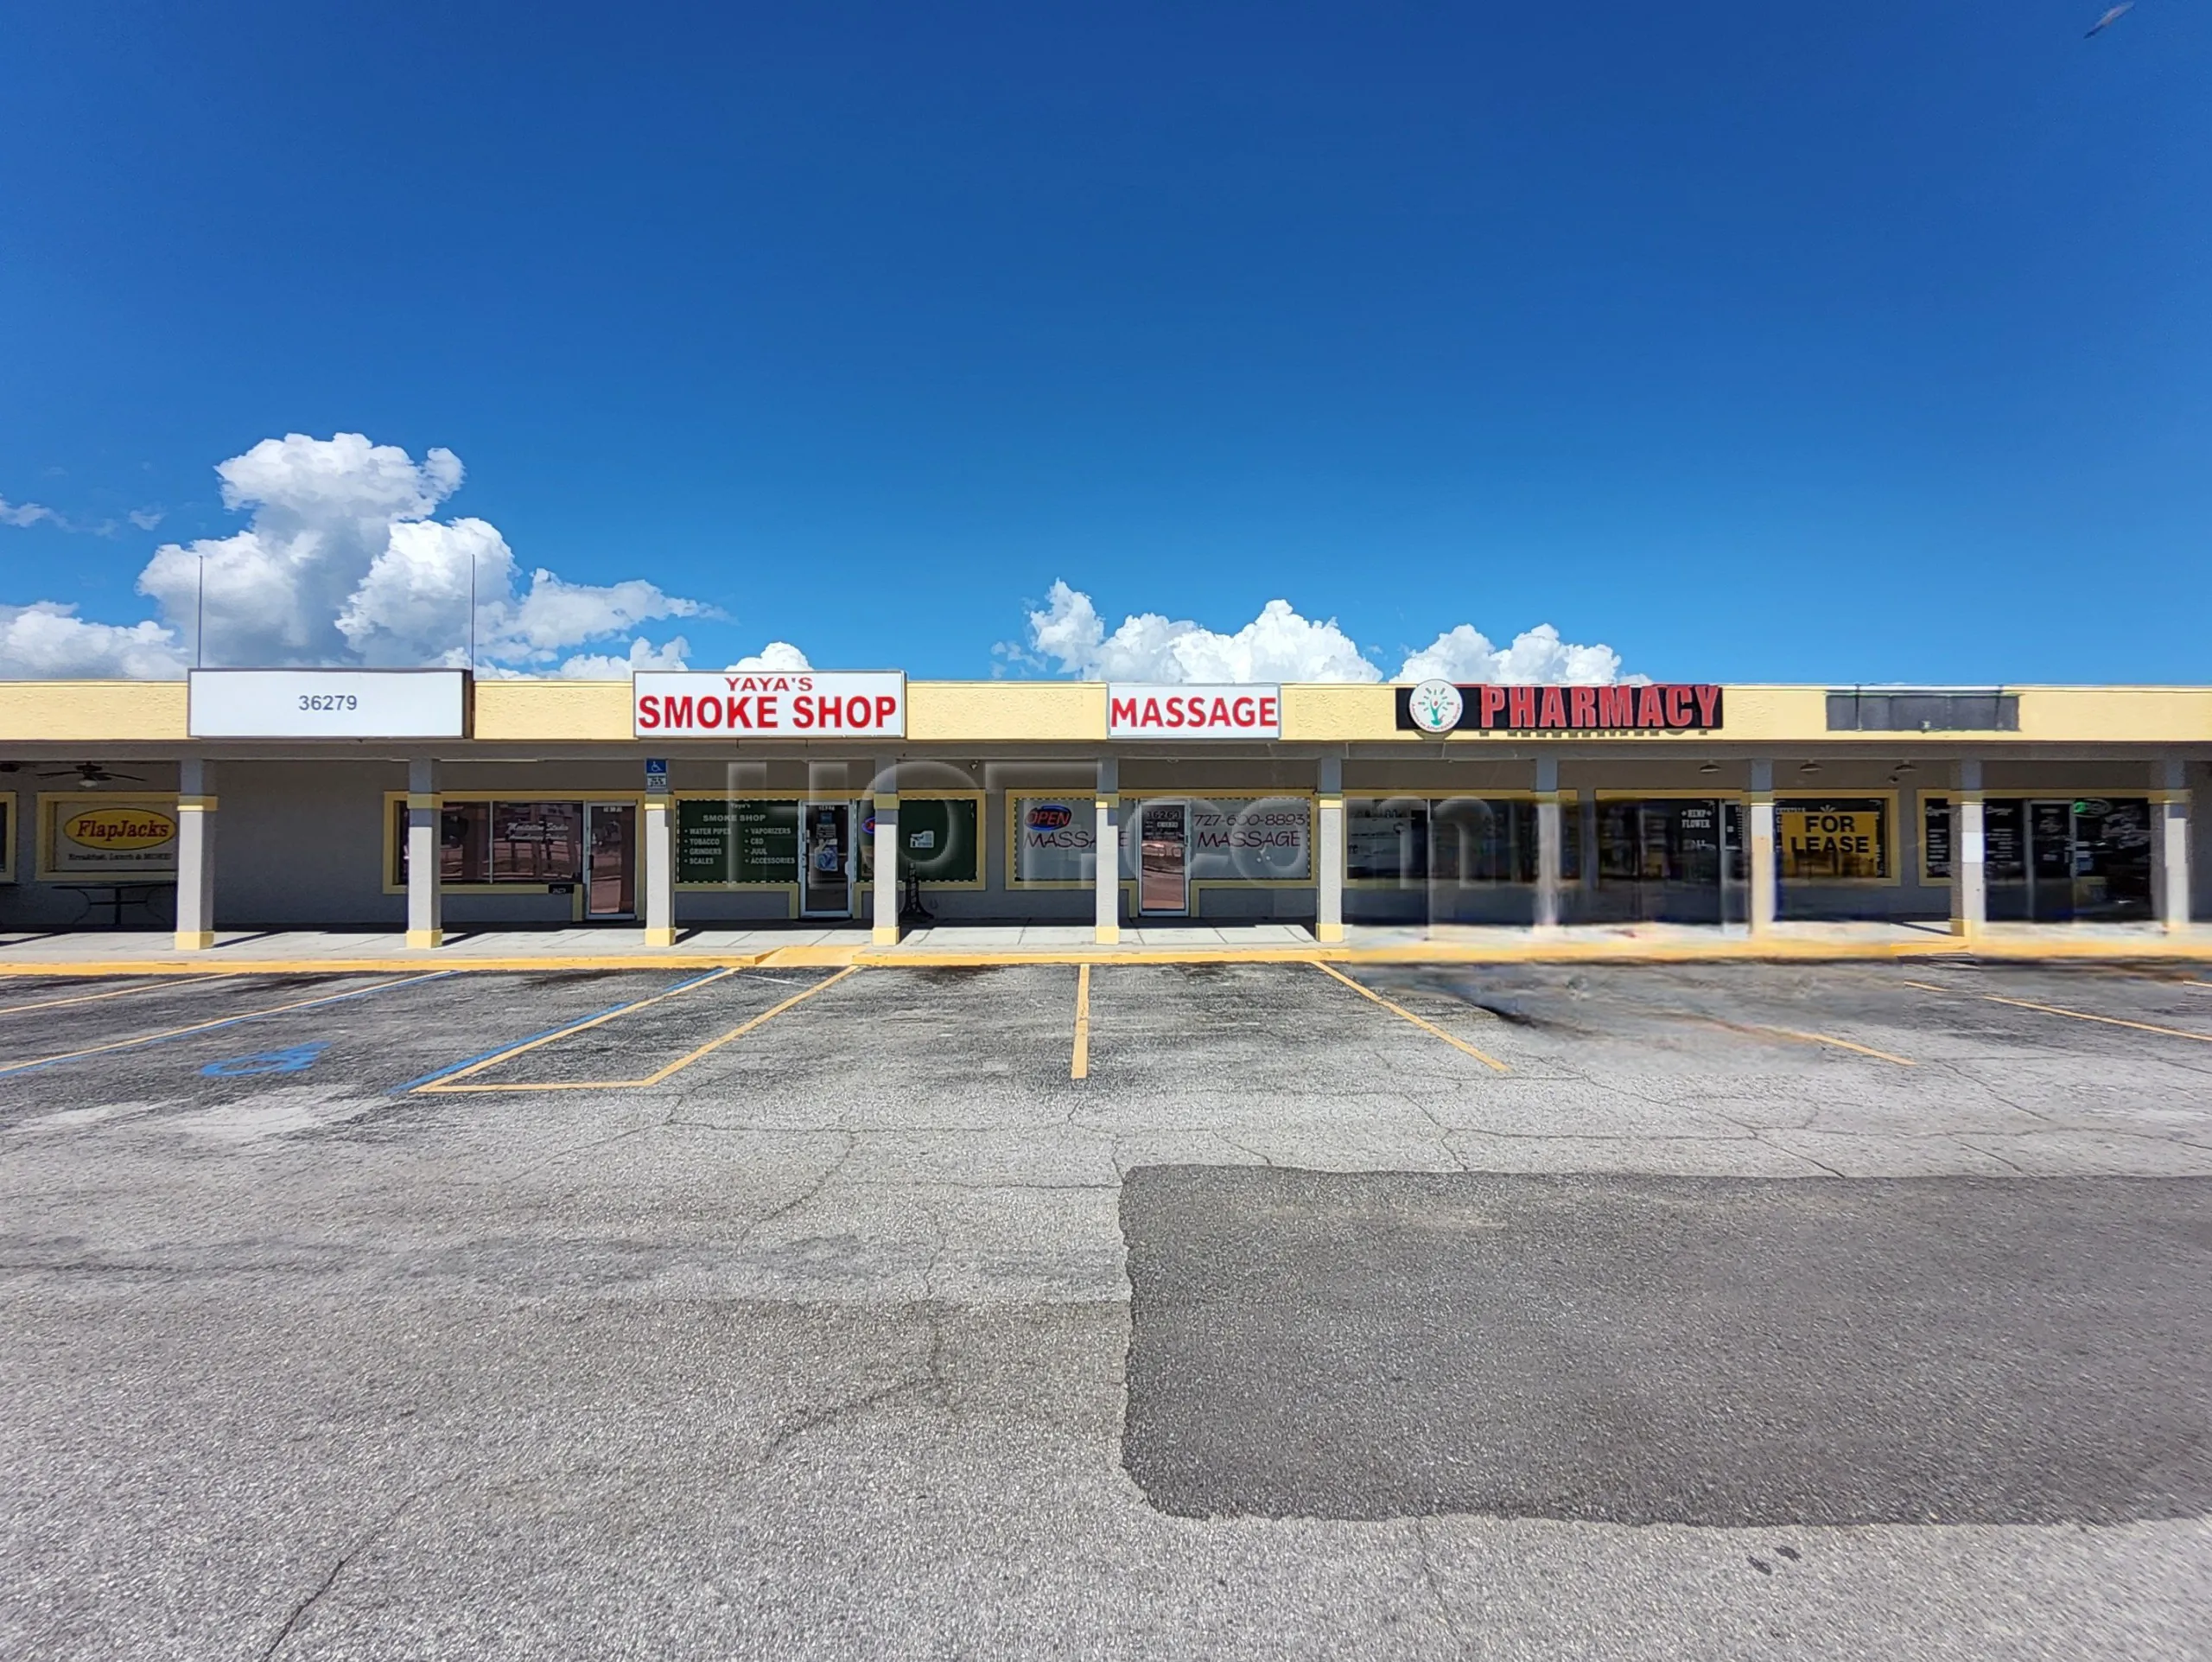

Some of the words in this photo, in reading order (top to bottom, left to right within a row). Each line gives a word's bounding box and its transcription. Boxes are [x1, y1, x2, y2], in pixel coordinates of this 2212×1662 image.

[725, 677, 813, 691] YAYA'S
[298, 695, 358, 710] 36279
[1480, 685, 1720, 728] PHARMACY
[638, 696, 779, 729] SMOKE
[792, 696, 896, 729] SHOP
[1111, 697, 1278, 728] MASSAGE
[1027, 812, 1070, 825] OPEN
[1193, 813, 1306, 826] 727-600-8893
[1805, 815, 1855, 833] FOR
[76, 820, 169, 841] FlapJacks
[1198, 831, 1300, 848] MASSAGE
[1791, 836, 1869, 853] LEASE
